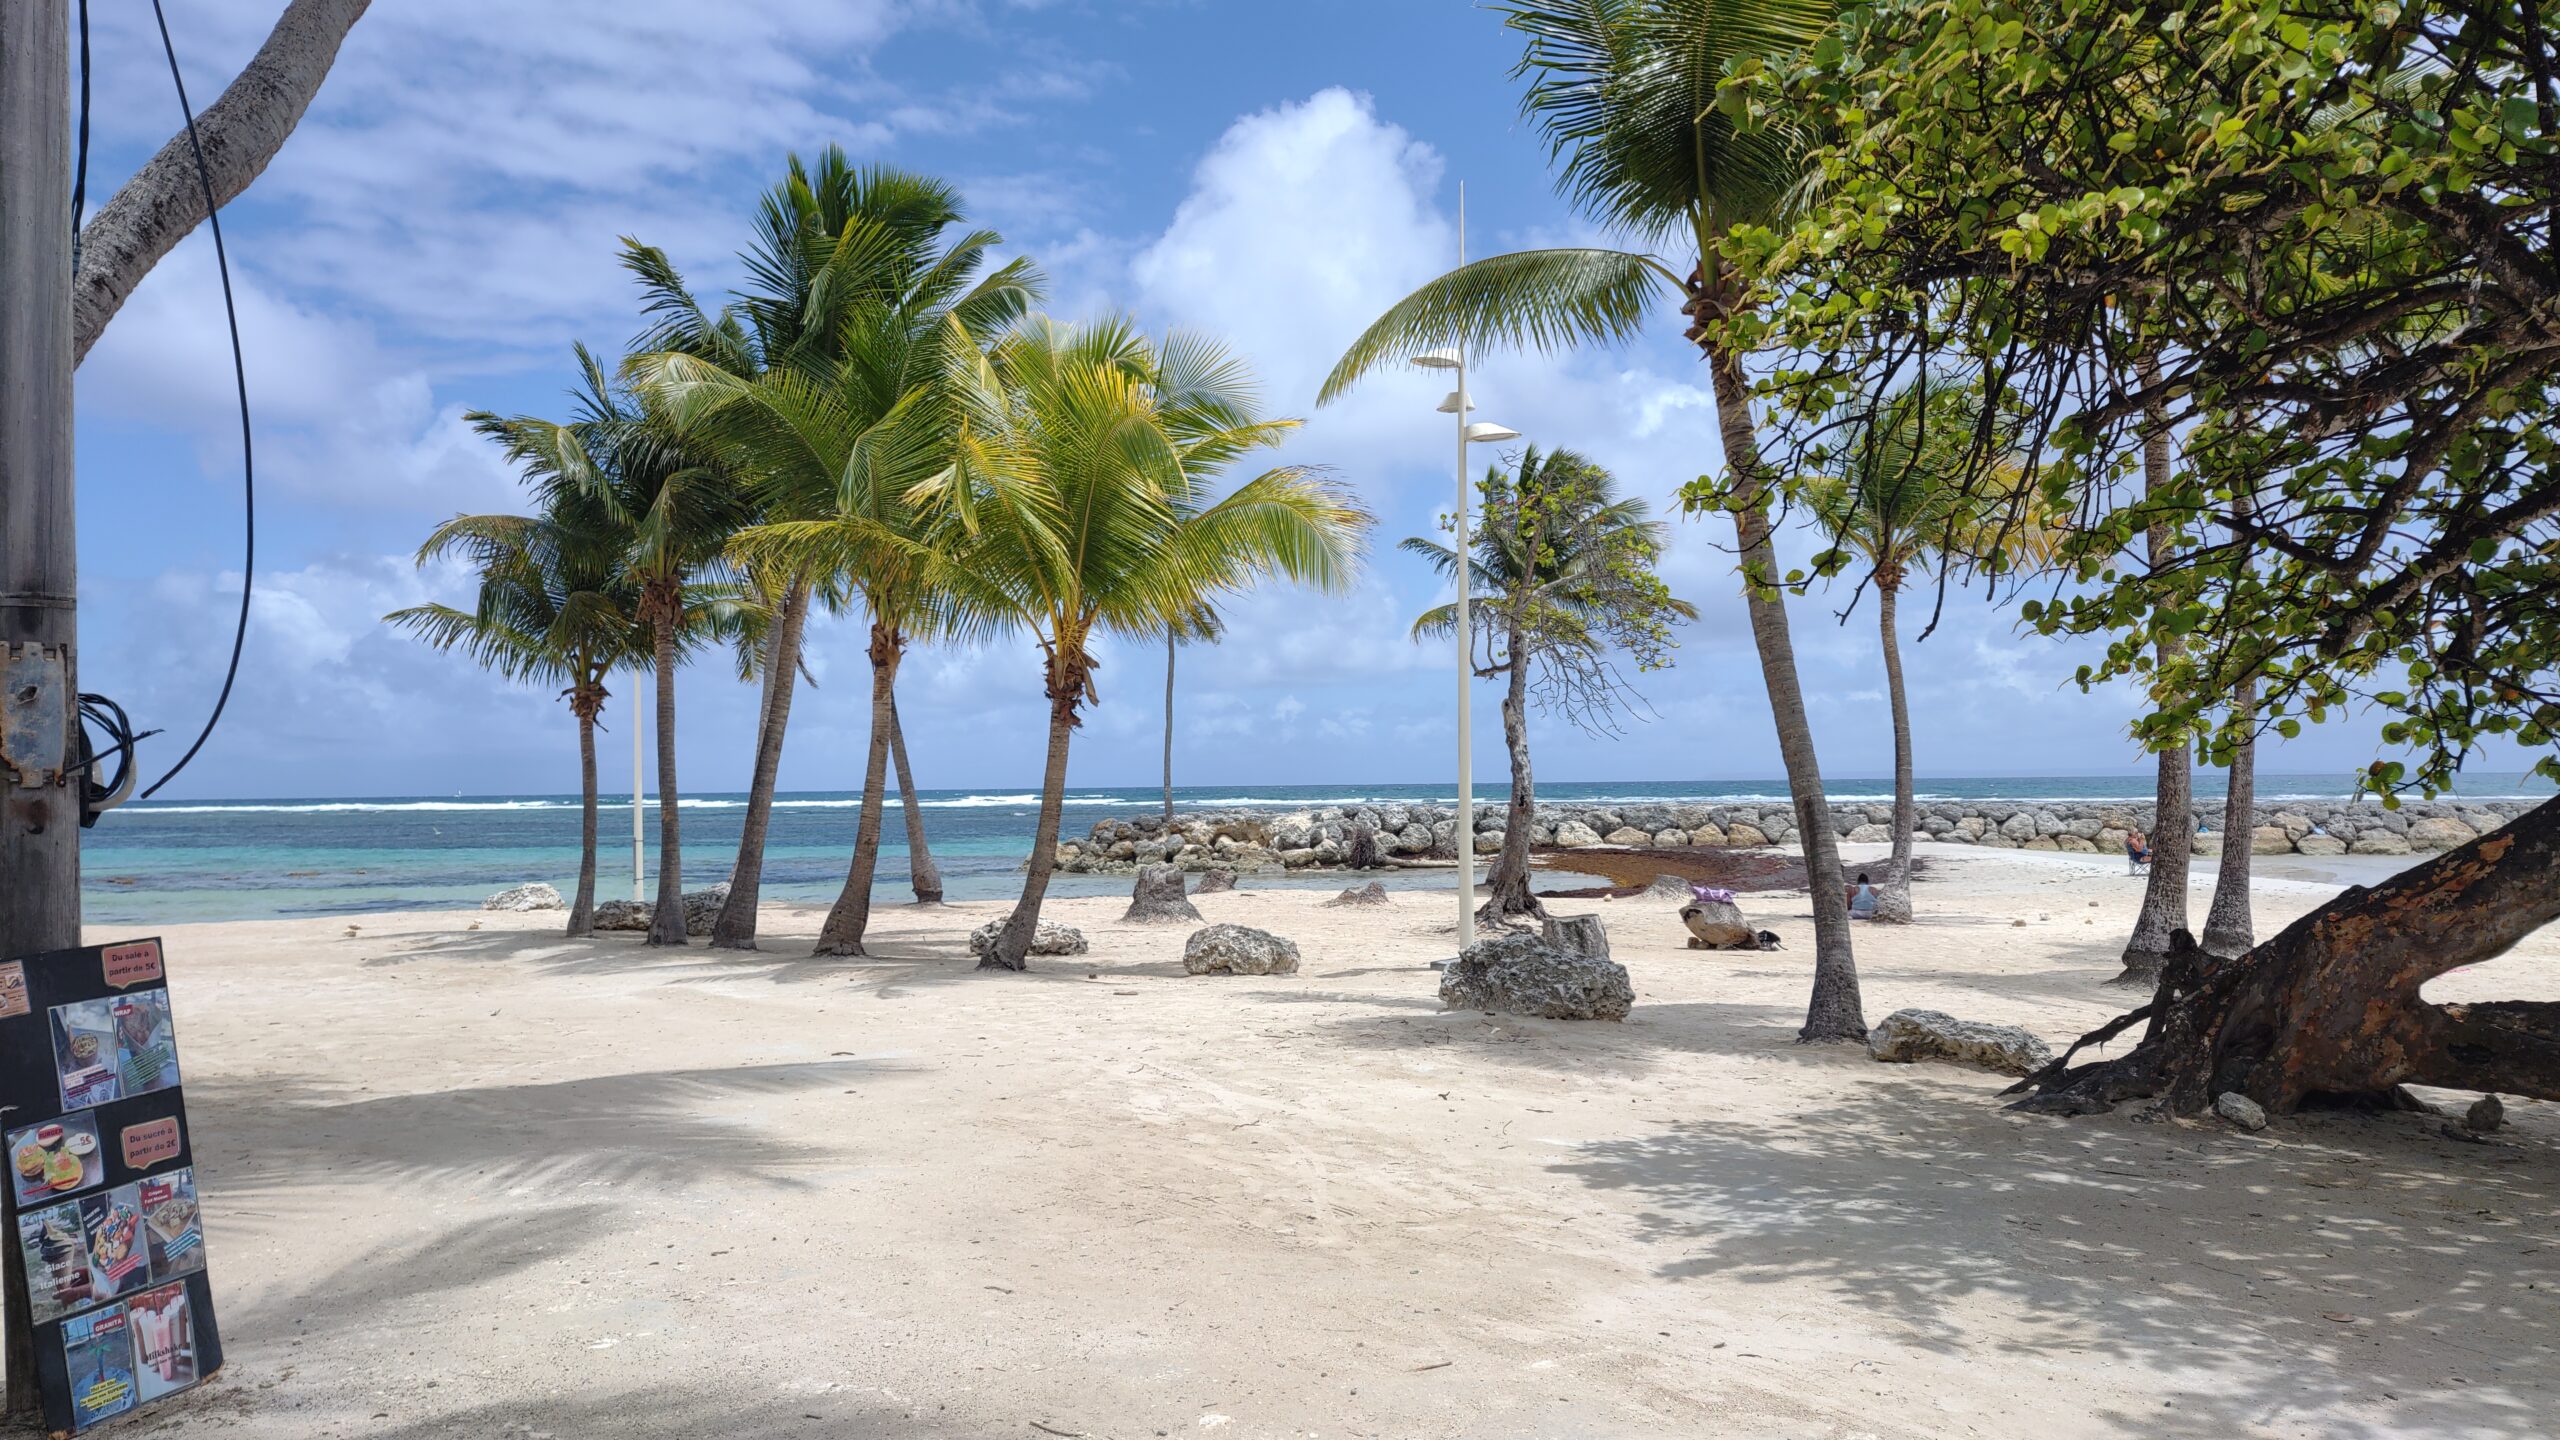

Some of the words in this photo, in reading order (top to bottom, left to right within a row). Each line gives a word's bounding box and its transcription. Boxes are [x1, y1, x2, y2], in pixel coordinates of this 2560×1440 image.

[112, 954, 122, 962] Du
[109, 966, 131, 977] partir
[145, 962, 155, 970] 5€
[114, 1008, 131, 1016] WRAP
[130, 1135, 140, 1143] Du
[130, 1146, 152, 1159] partir
[166, 1139, 176, 1148] 2€
[45, 1260, 71, 1273] Glace
[40, 1272, 80, 1290] Italienne
[95, 1318, 122, 1332] GRANITA
[146, 1343, 183, 1361] Milkshake
